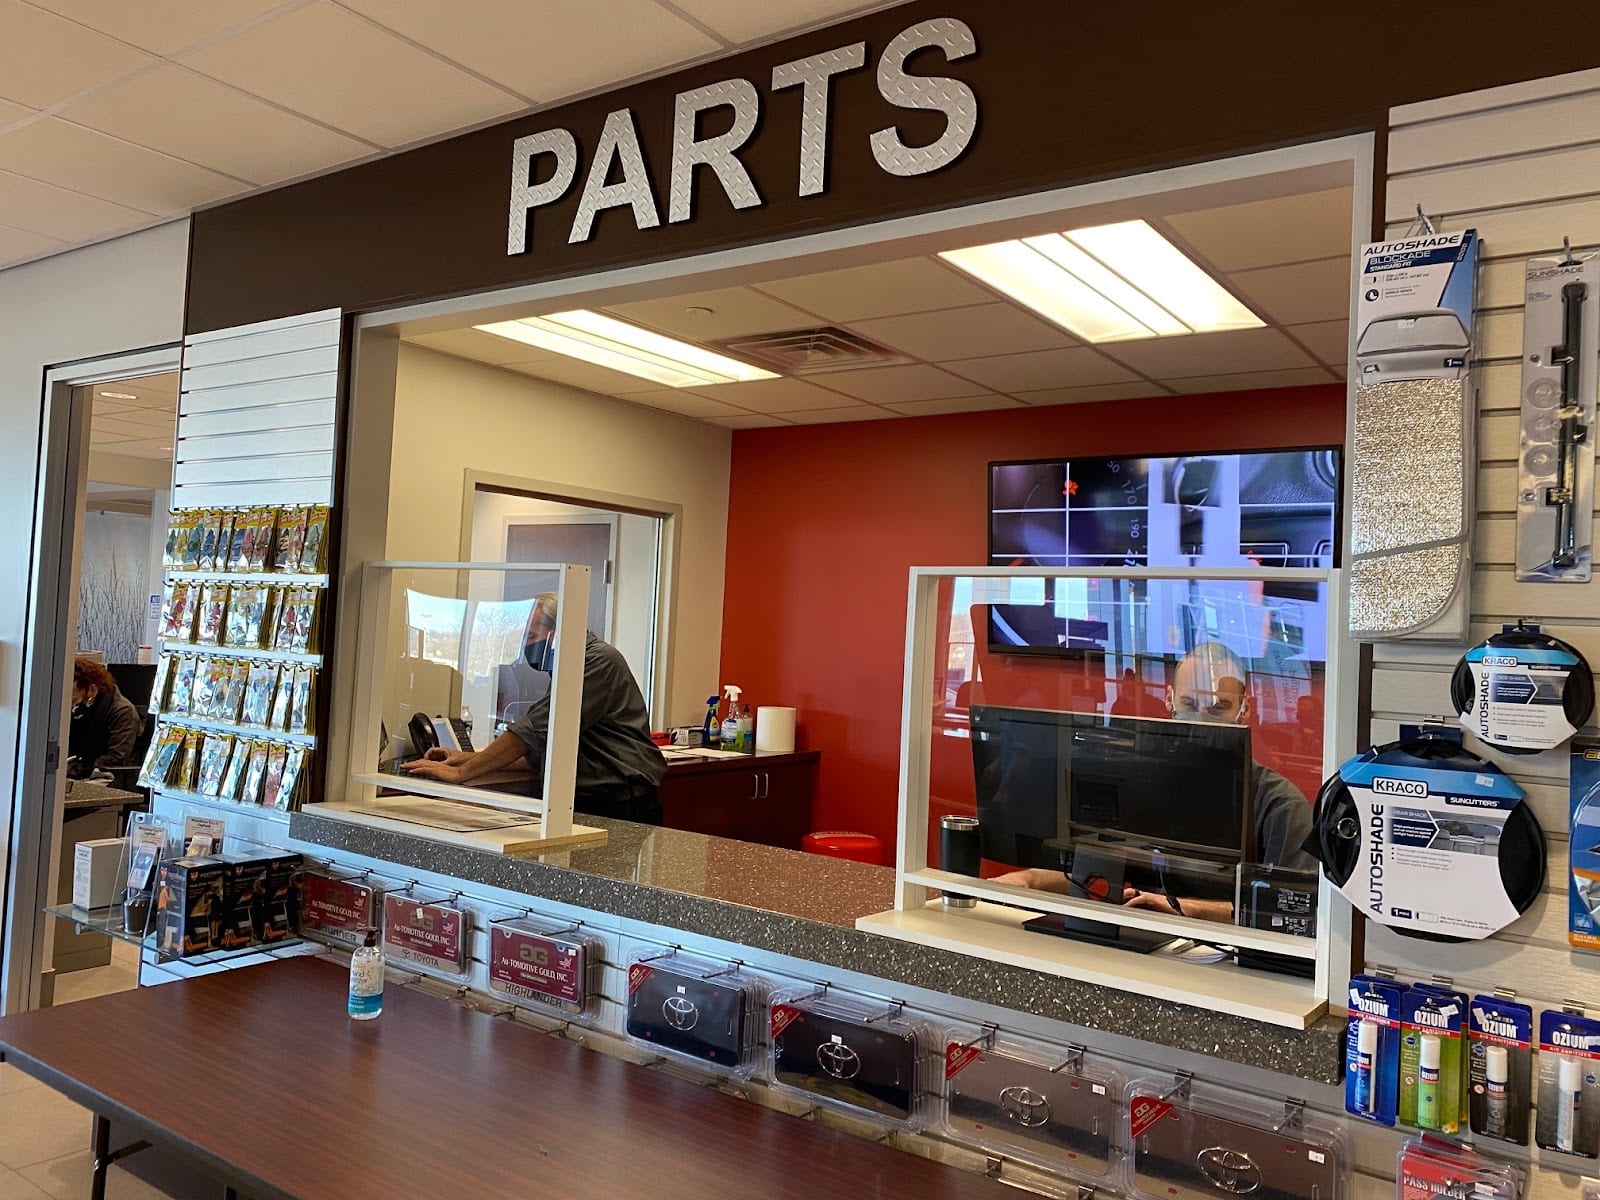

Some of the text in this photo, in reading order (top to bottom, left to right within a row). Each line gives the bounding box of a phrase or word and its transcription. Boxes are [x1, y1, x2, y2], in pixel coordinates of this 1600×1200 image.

[507, 17, 977, 256] PARTS
[1364, 234, 1461, 256] AUTOSHADE
[1369, 250, 1431, 265] BLOCKADE
[1484, 657, 1516, 666] KRACO
[1480, 672, 1490, 738] AUTOSHADE
[1376, 780, 1425, 795] KRACO
[1450, 797, 1499, 807] SUNCUTTERS
[1370, 804, 1384, 914] AUTOSHADE
[413, 952, 440, 968] TOYOTA
[505, 983, 562, 1008] HIGHLANDER
[1358, 998, 1389, 1018] OZIUM
[1414, 1010, 1448, 1029] OZIUM
[1482, 1019, 1518, 1039] OZIUM
[1552, 1030, 1589, 1050] OZIUM
[1403, 1174, 1429, 1190] PASS
